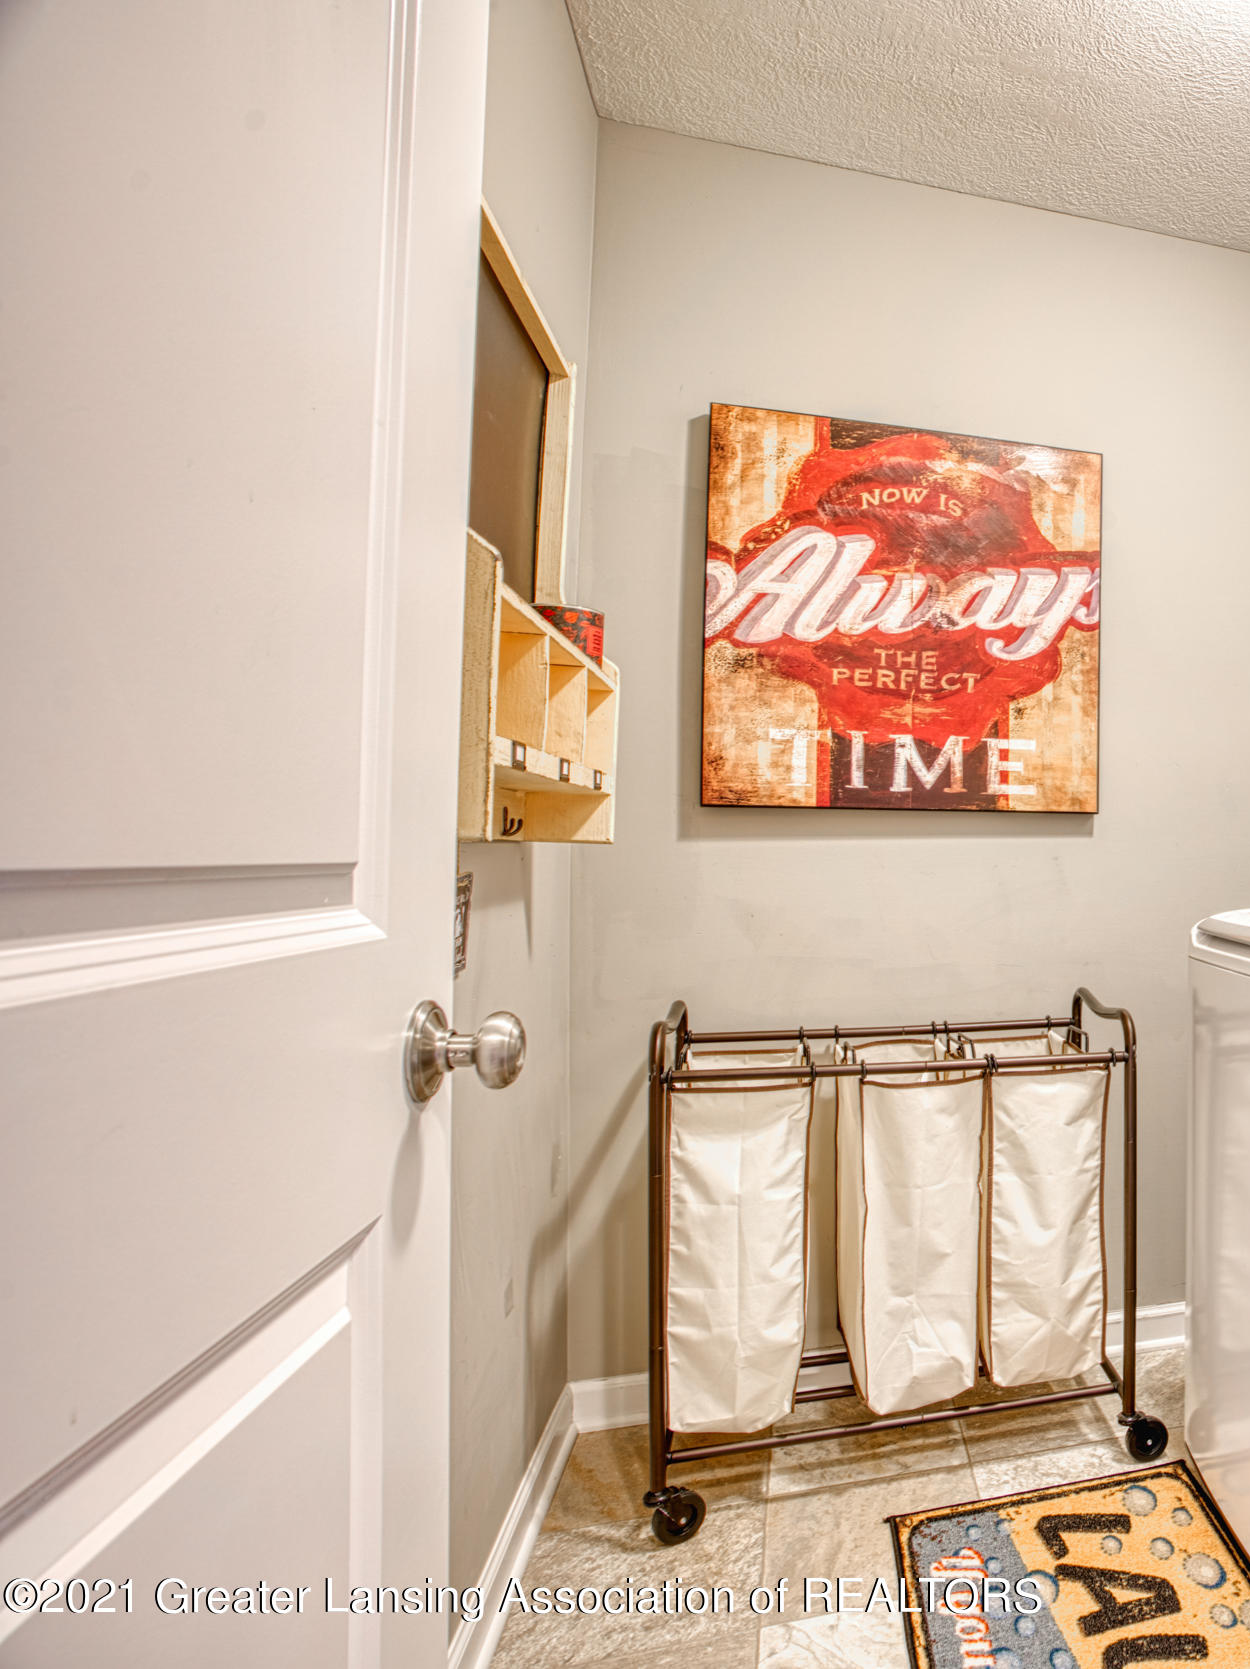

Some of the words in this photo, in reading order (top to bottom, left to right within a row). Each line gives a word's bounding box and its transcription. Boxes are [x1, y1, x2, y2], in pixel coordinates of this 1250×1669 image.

[860, 487, 928, 510] NOW
[939, 493, 964, 517] IS
[874, 648, 939, 670] THE
[832, 667, 981, 694] PERFECT
[769, 726, 1037, 797] TIME
